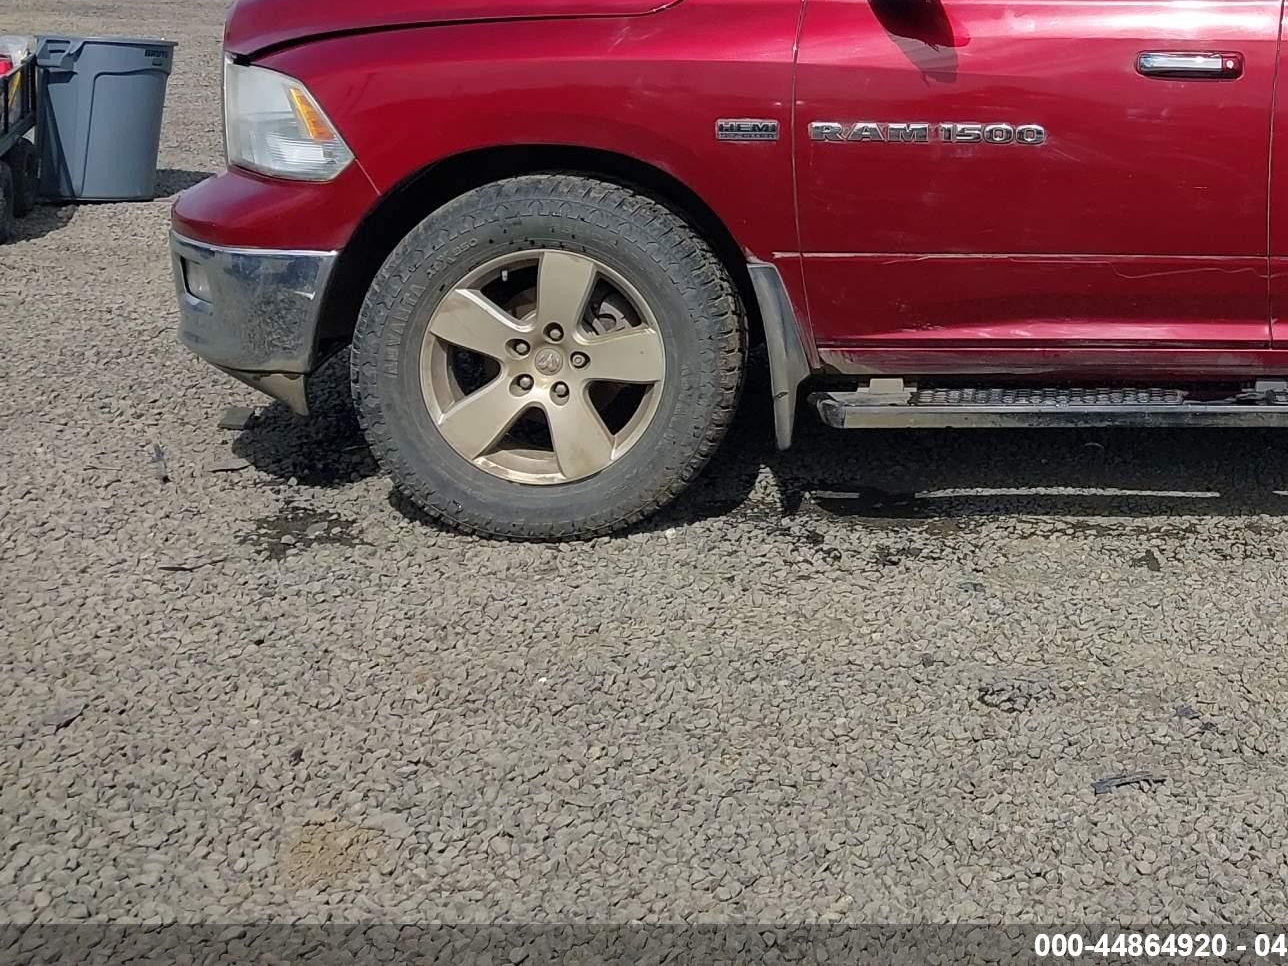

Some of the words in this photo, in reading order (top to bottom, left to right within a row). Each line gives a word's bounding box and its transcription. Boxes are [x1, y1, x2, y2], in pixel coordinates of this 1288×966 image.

[718, 121, 778, 133] HEMI
[808, 122, 930, 142] RAM
[938, 123, 1047, 145] 1500
